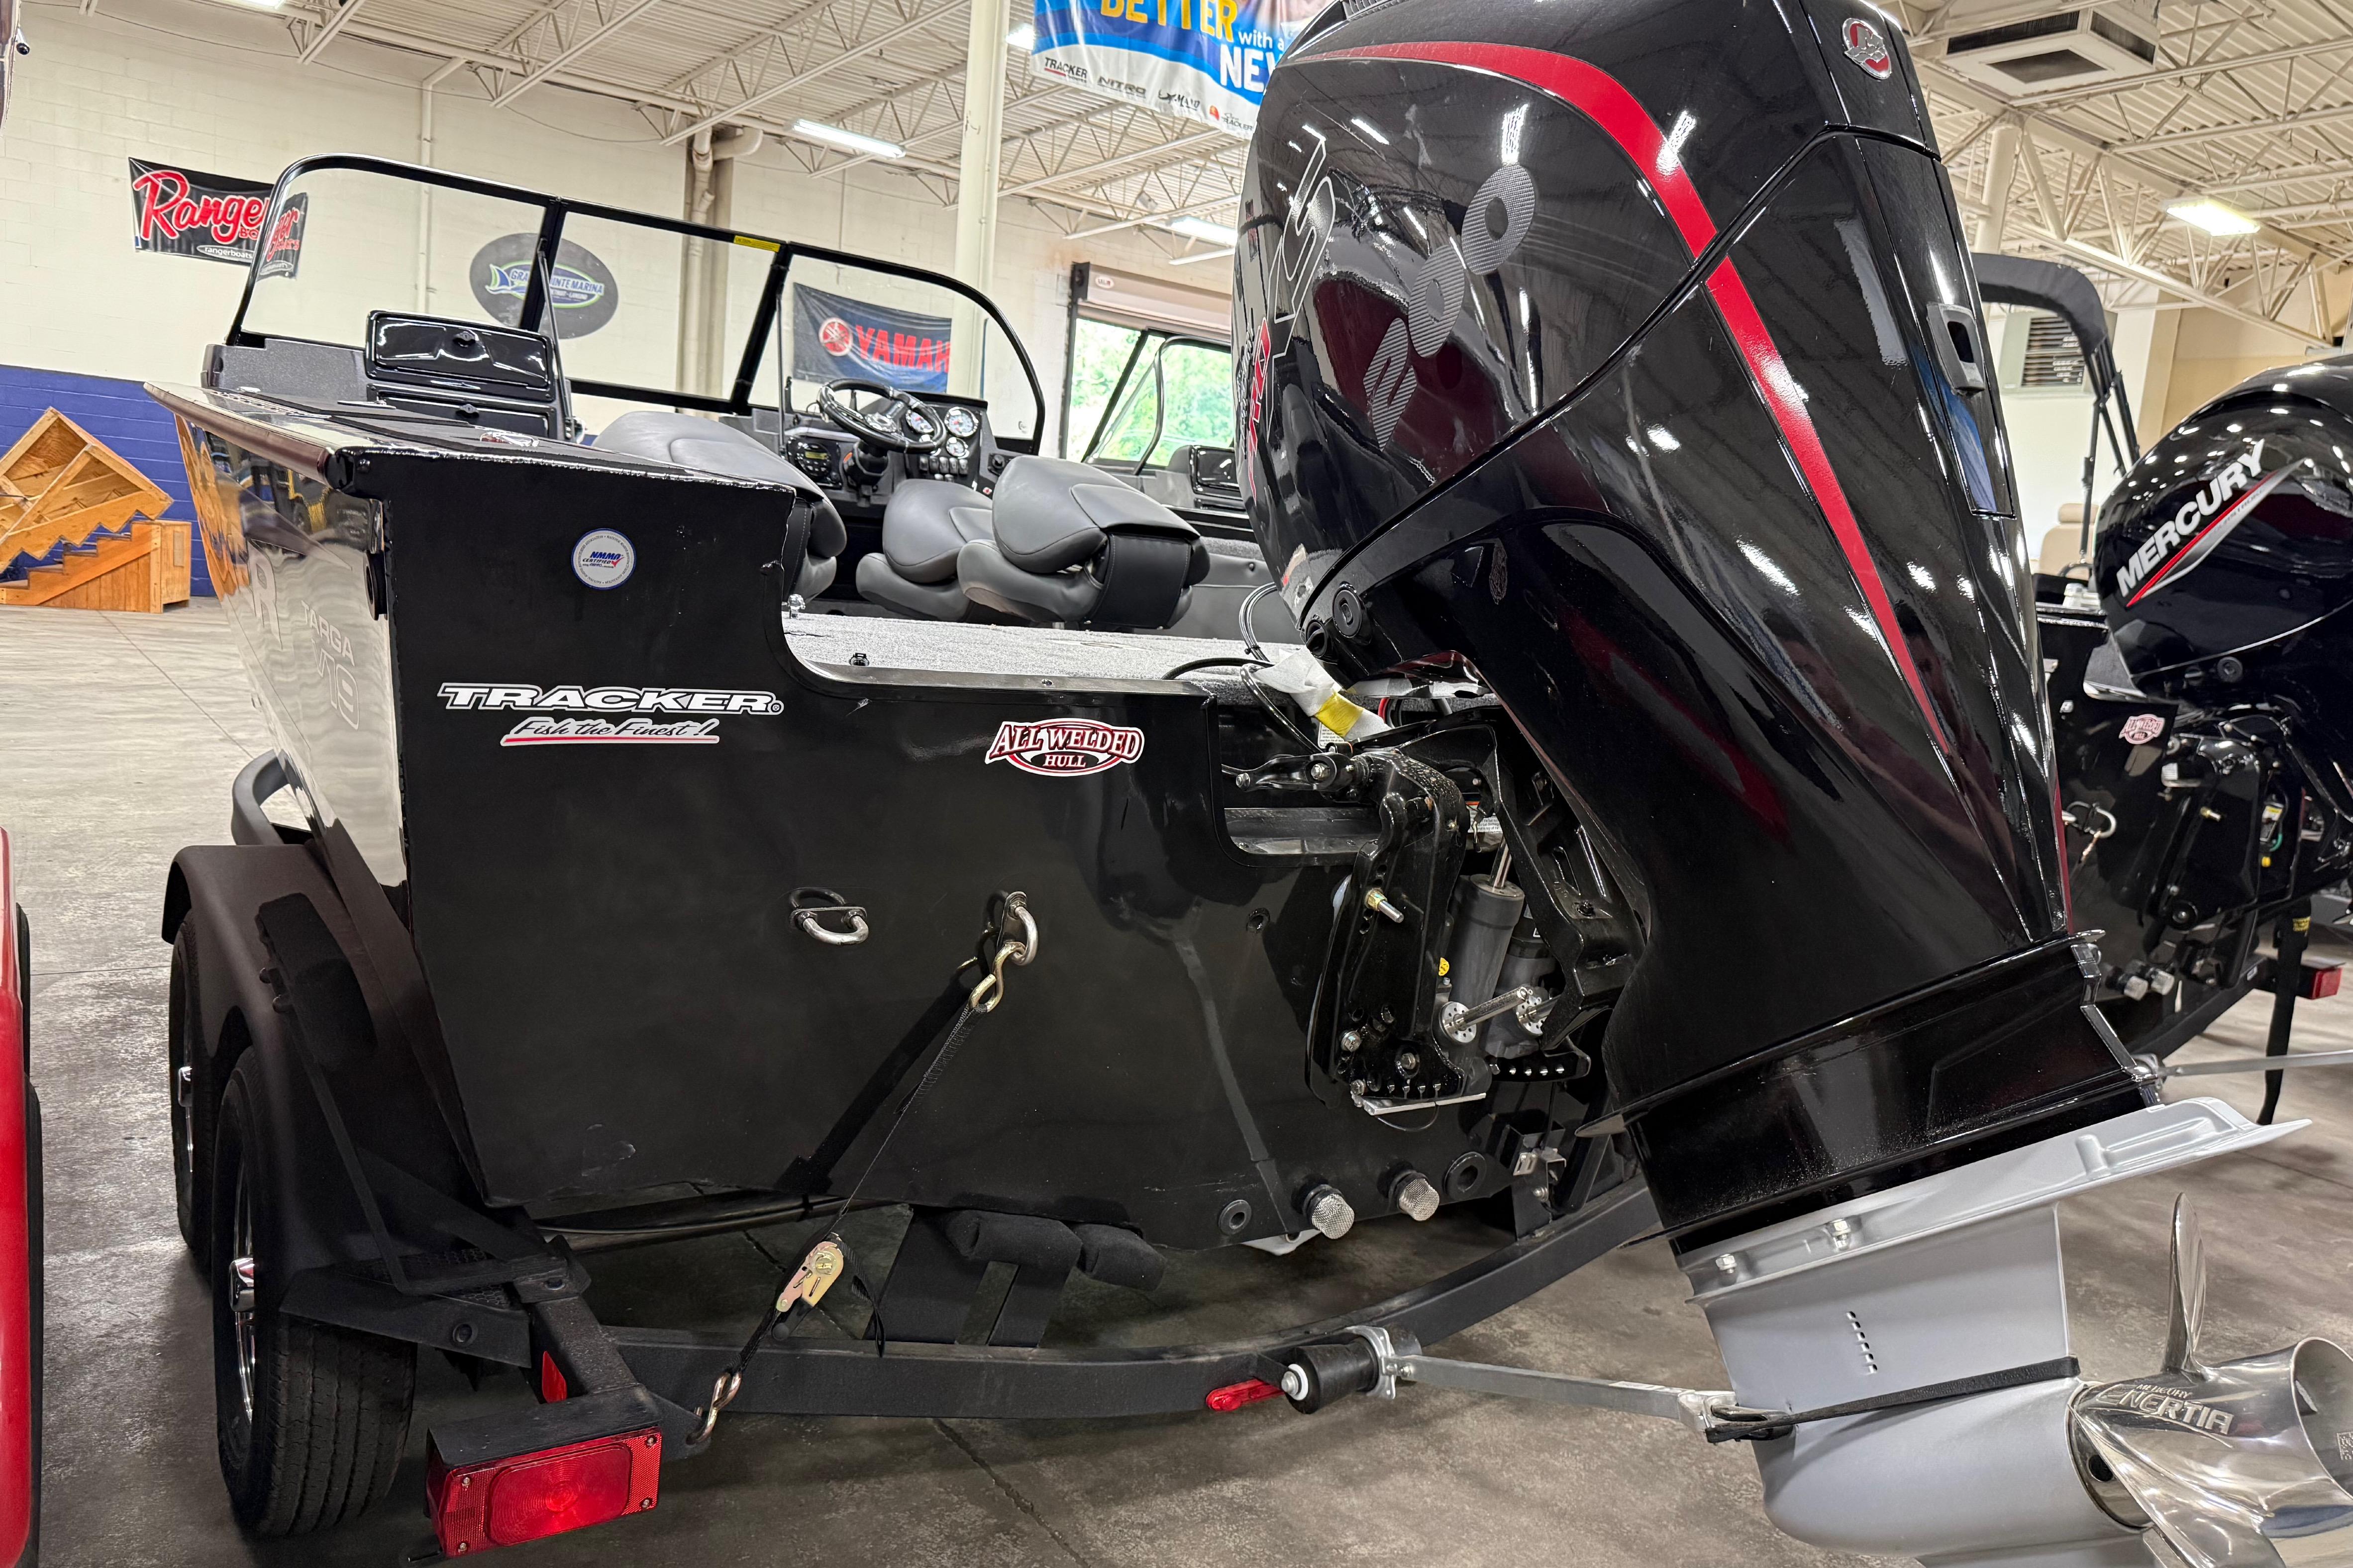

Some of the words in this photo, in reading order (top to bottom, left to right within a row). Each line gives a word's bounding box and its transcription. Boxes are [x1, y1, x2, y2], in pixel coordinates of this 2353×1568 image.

[1238, 30, 1273, 49] with
[1277, 40, 1285, 50] a
[1045, 57, 1088, 79] TRACKER
[1098, 76, 1146, 96] NITRO
[512, 270, 527, 281] GRA
[551, 278, 572, 289] INTE
[572, 281, 603, 293] MARINA
[1363, 164, 1535, 452] 200
[855, 325, 951, 373] YAMAH
[1248, 316, 1271, 507] PRO
[2116, 438, 2264, 597] MERCURY
[590, 551, 621, 560] NMMA
[301, 600, 355, 667] TARGA
[311, 638, 359, 730] V19
[513, 720, 570, 735] Fish
[574, 720, 614, 735] the
[989, 724, 1043, 760] ALL
[1047, 726, 1142, 760] WELDED
[1042, 754, 1087, 768] HULL
[2136, 1384, 2189, 1399] MERCURY
[2096, 1384, 2234, 1435] ENERTIA
